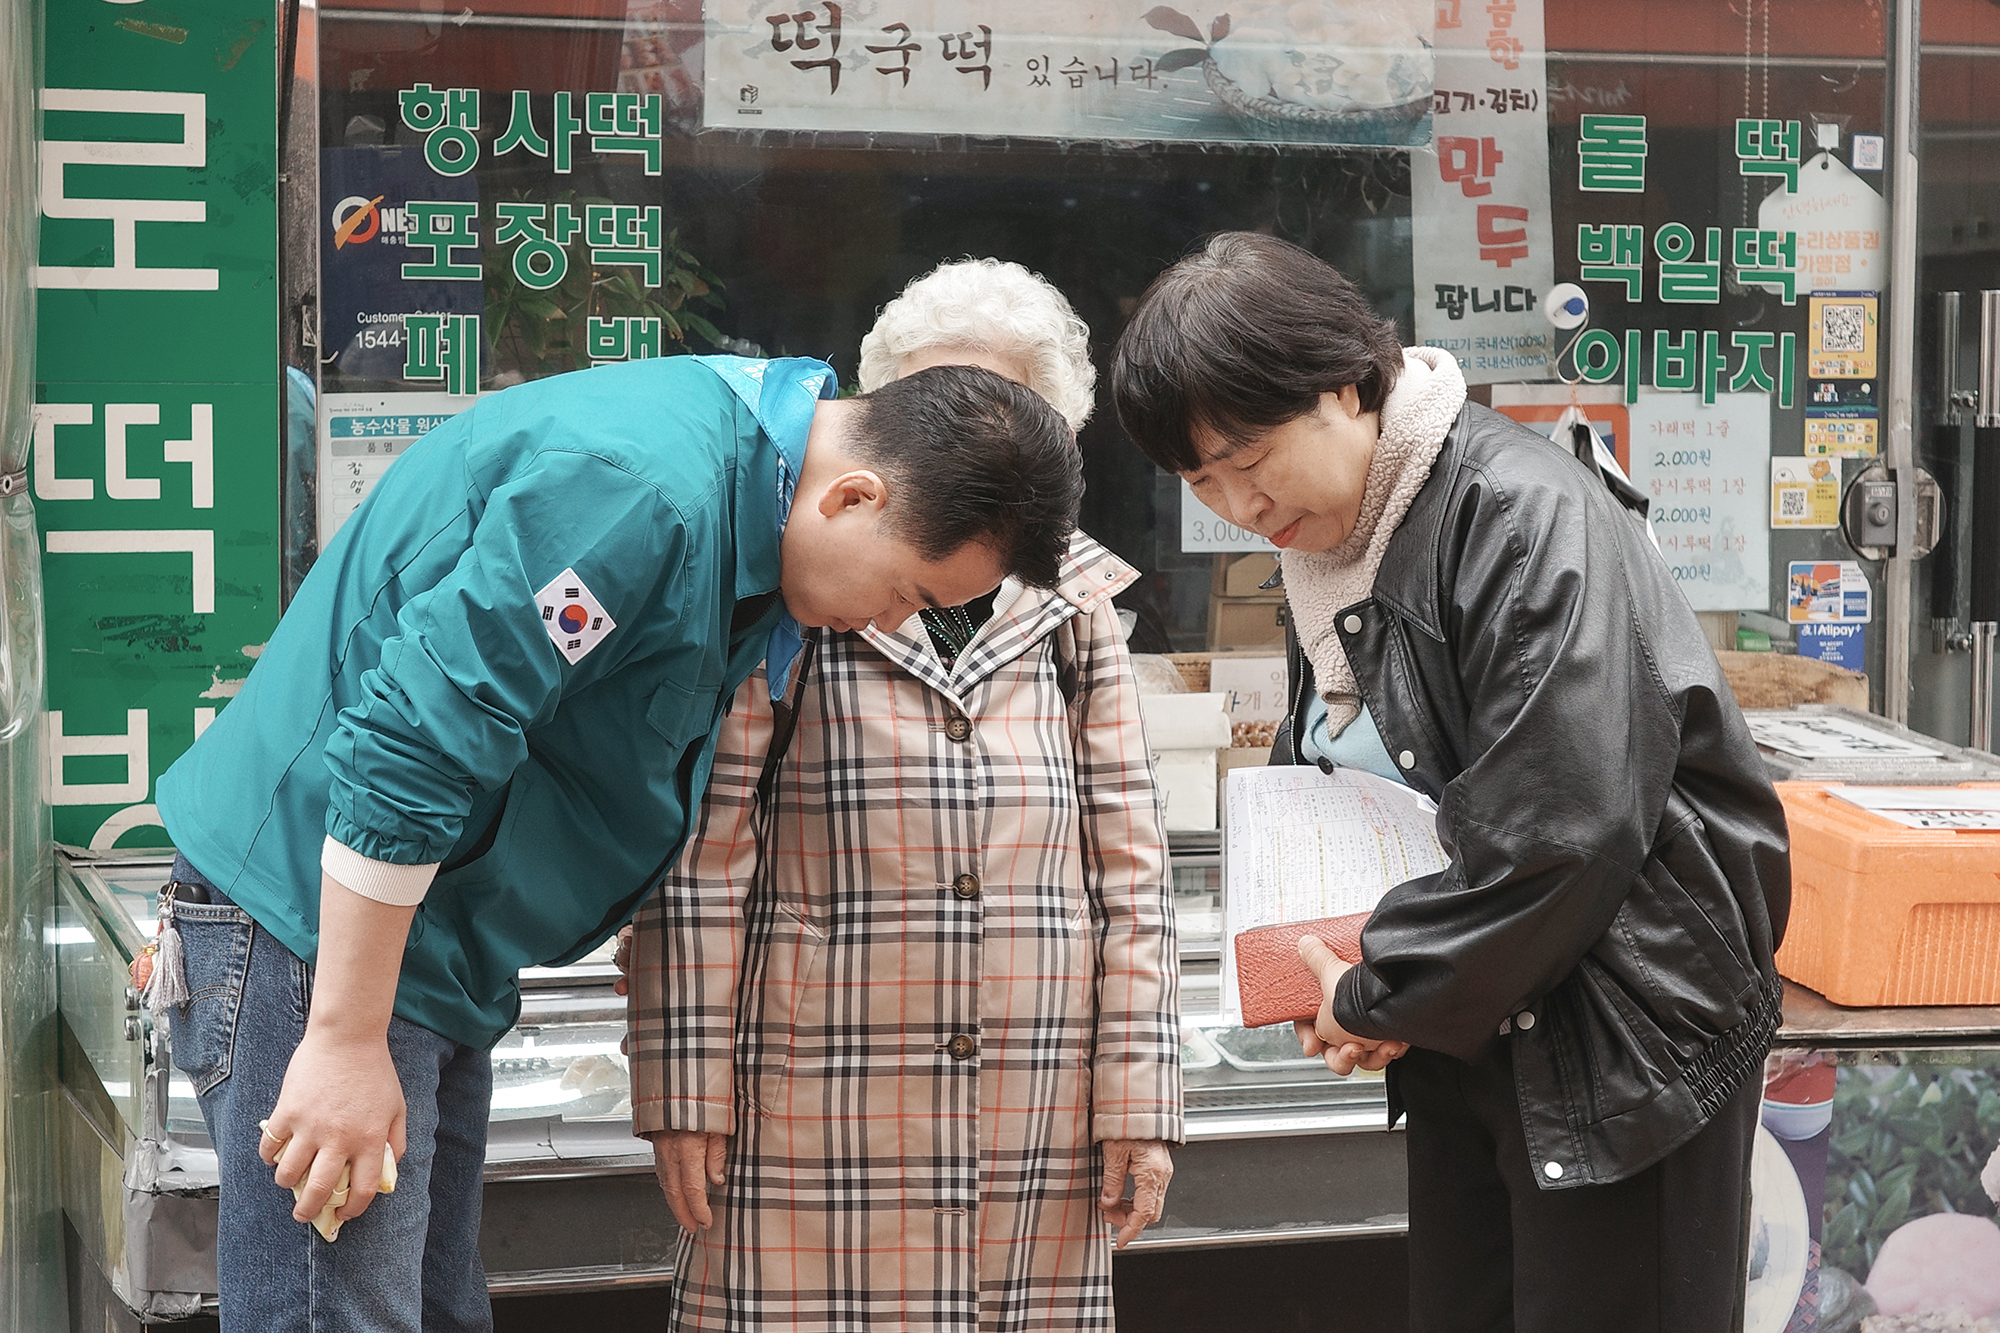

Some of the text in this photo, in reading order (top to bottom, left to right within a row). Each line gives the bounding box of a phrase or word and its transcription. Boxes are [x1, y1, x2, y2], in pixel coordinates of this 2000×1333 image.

[765, 1, 1169, 96] 떡국떡 있습니다.
[399, 83, 663, 177] 행사떡
[1578, 114, 1648, 193] 돌
[1735, 118, 1801, 195] 떡
[1438, 135, 1530, 269] 만두
[381, 235, 406, 245] 해충방
[401, 201, 663, 290] 포장떡
[1577, 222, 1798, 306] 백일떡
[357, 312, 408, 324] Custome
[1435, 284, 1538, 321] 팝니다
[355, 329, 408, 349] 1544-
[402, 314, 481, 397] 폐
[1456, 356, 1472, 370] 치
[1573, 329, 1798, 410] 이바지
[29, 0, 219, 850] 로떡방
[350, 418, 412, 436] 농수산물
[1650, 419, 1696, 437] 가래떡
[1193, 520, 1271, 544] 3,000
[1656, 535, 1712, 553] 시루떡
[1672, 563, 1712, 583] 000원
